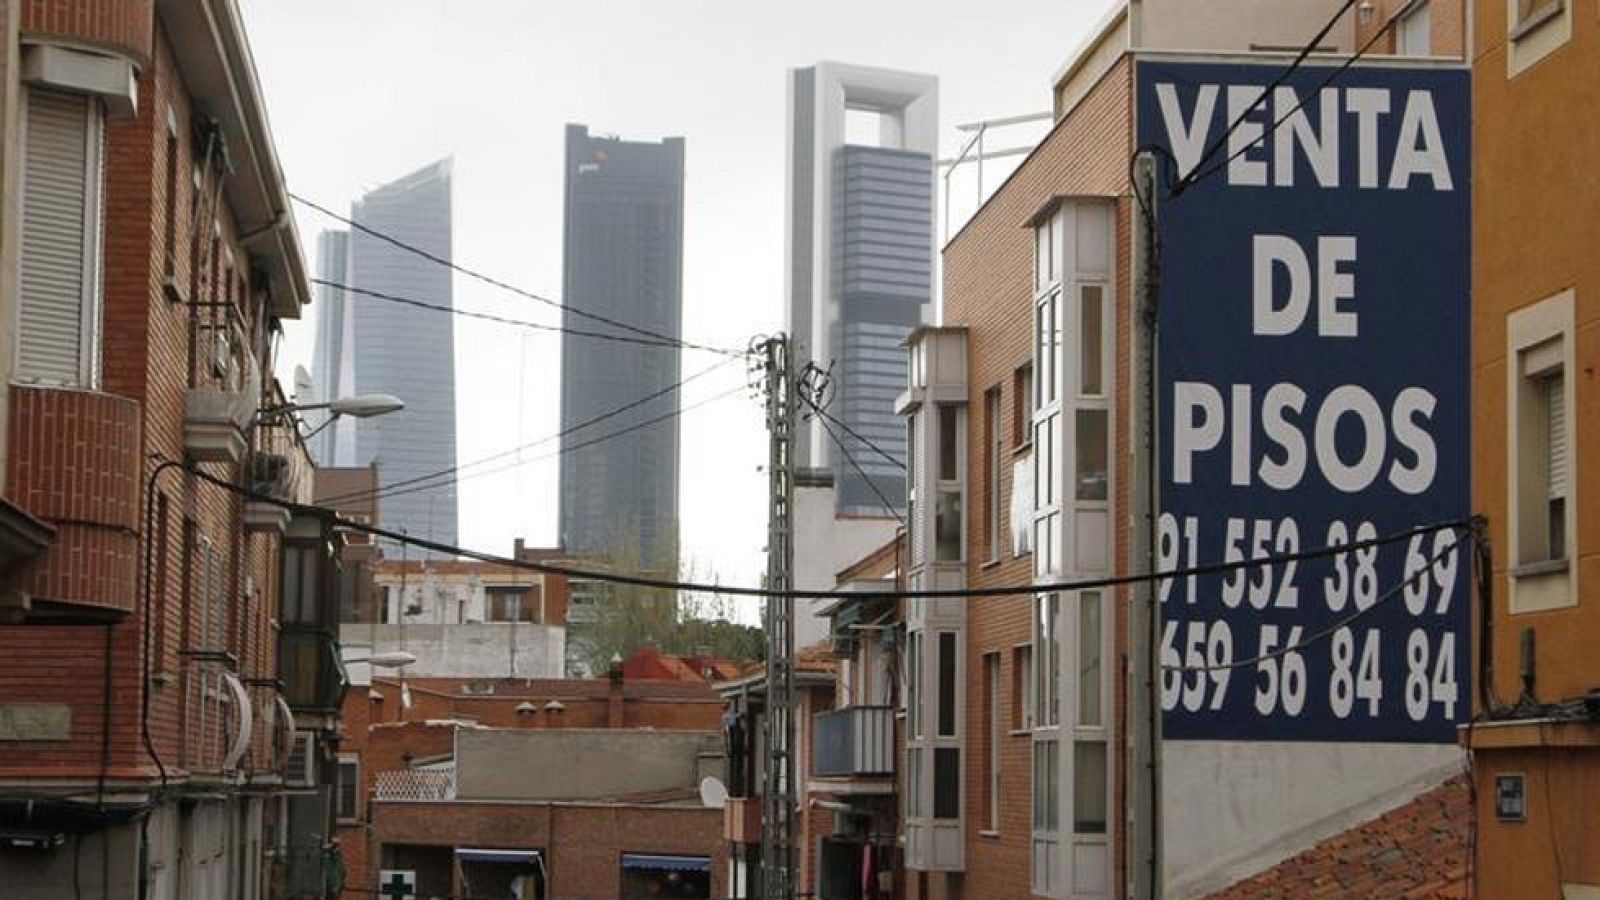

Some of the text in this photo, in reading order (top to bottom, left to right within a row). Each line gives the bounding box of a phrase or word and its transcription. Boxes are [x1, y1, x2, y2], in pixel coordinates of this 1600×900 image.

[1155, 82, 1453, 190] VENTA
[1254, 234, 1357, 336] DE
[1174, 382, 1437, 494] PISOS
[1158, 512, 1458, 616] 91 552 38 69
[1160, 619, 1458, 721] 659 56 84 84
